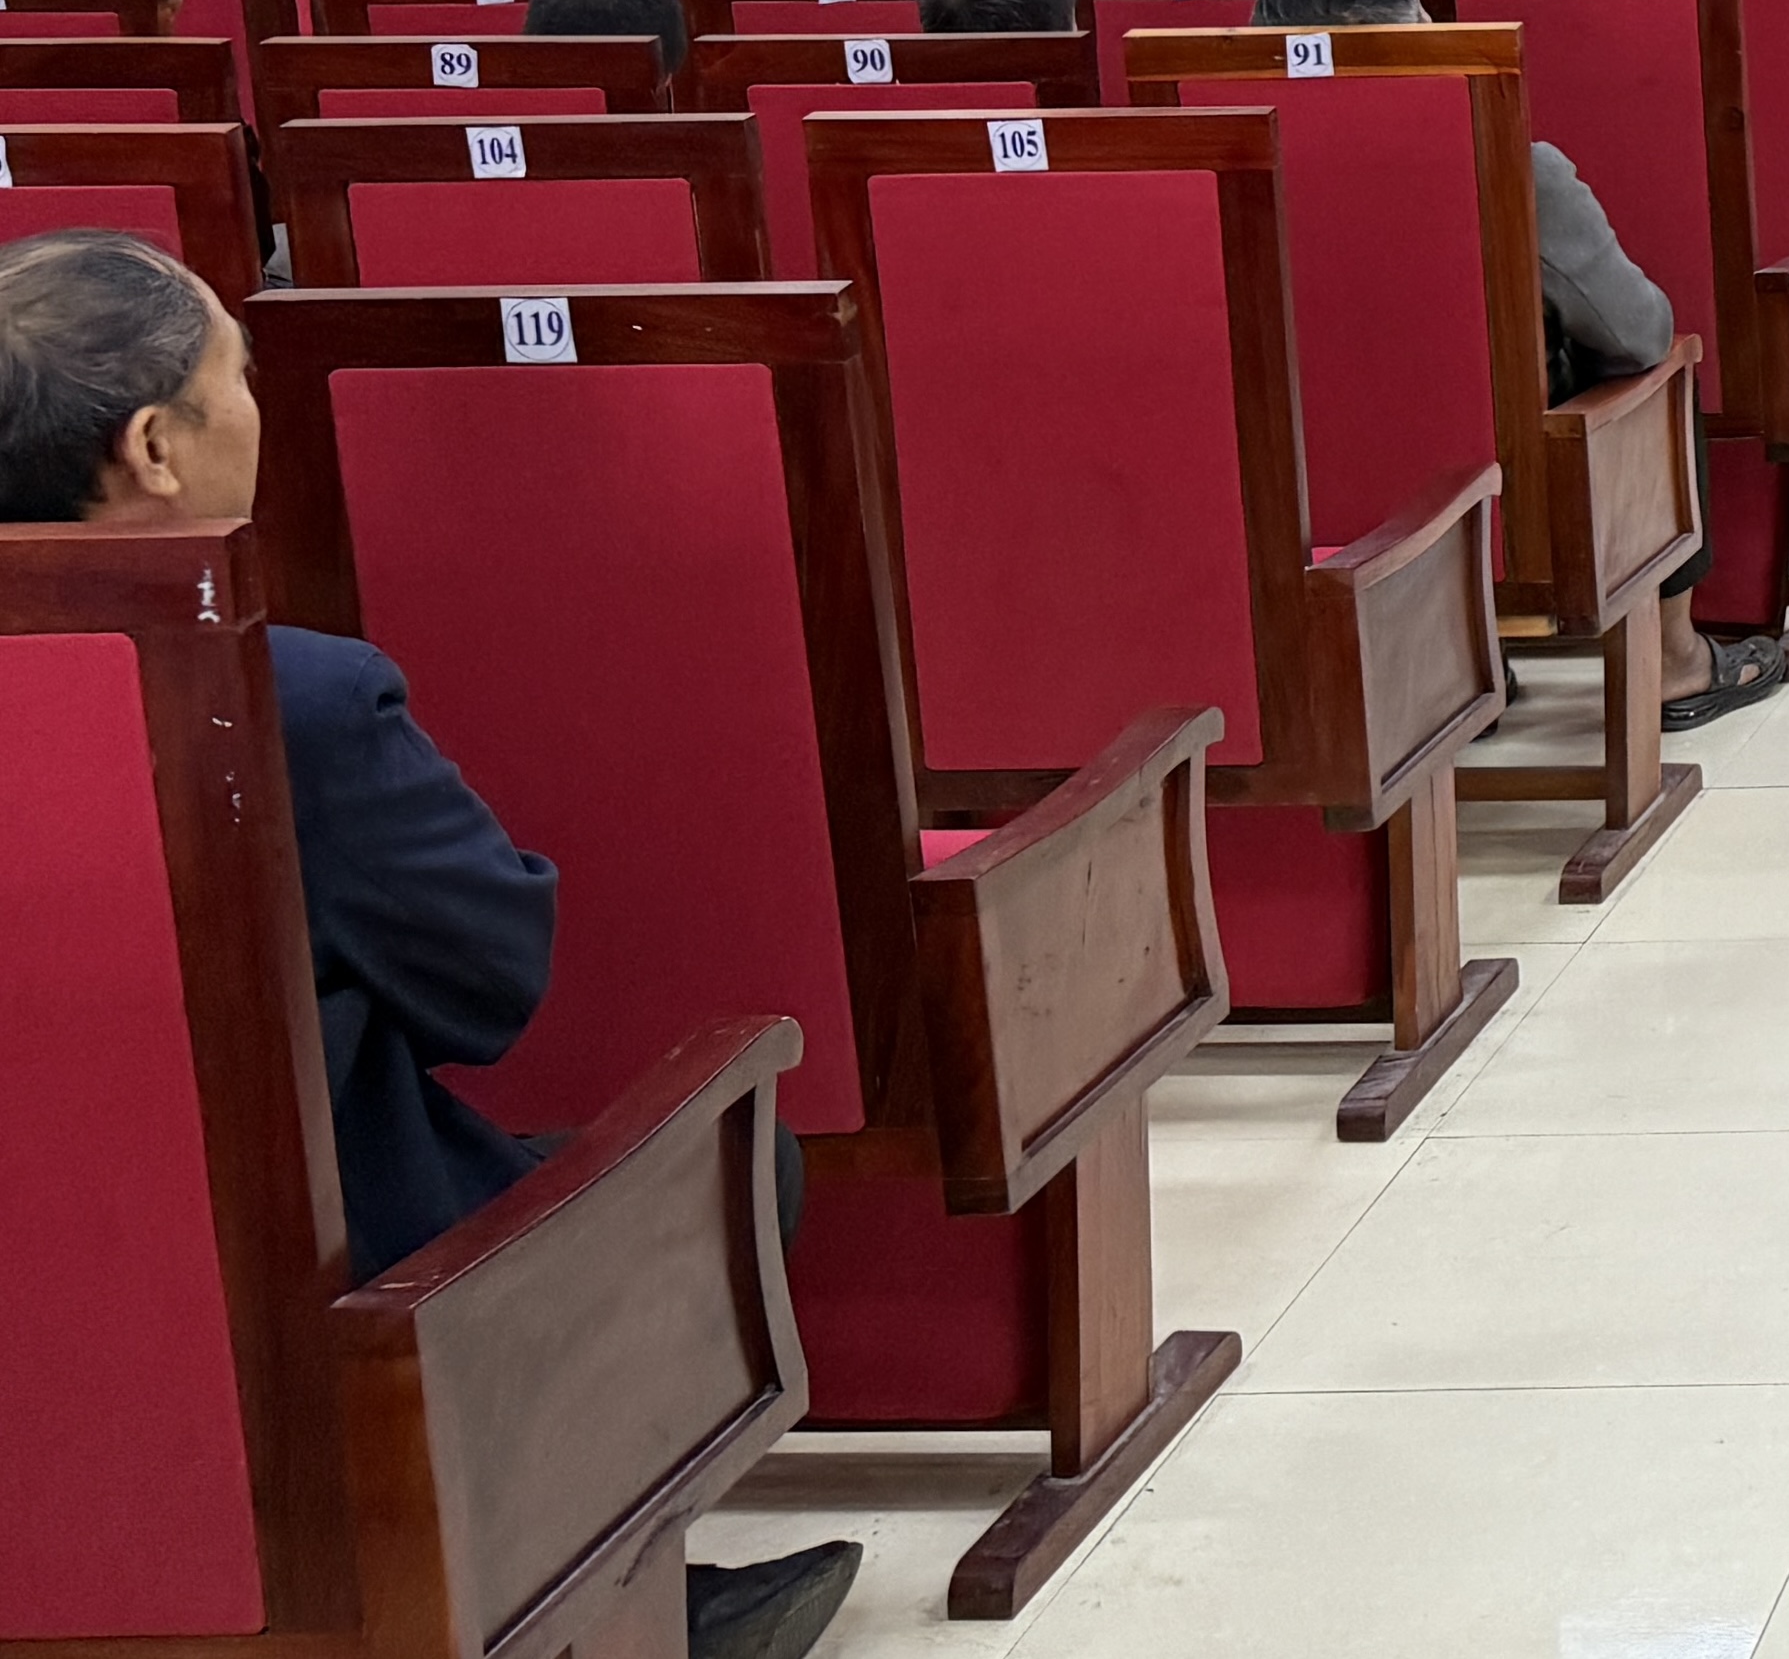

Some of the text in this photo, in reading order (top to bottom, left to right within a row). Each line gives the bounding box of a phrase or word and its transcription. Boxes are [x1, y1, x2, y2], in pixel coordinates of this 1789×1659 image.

[440, 52, 472, 76] 89
[852, 48, 886, 73] 90
[1293, 43, 1324, 66] 91
[477, 136, 518, 165] 104
[999, 130, 1039, 159] 105
[513, 311, 564, 346] 119
